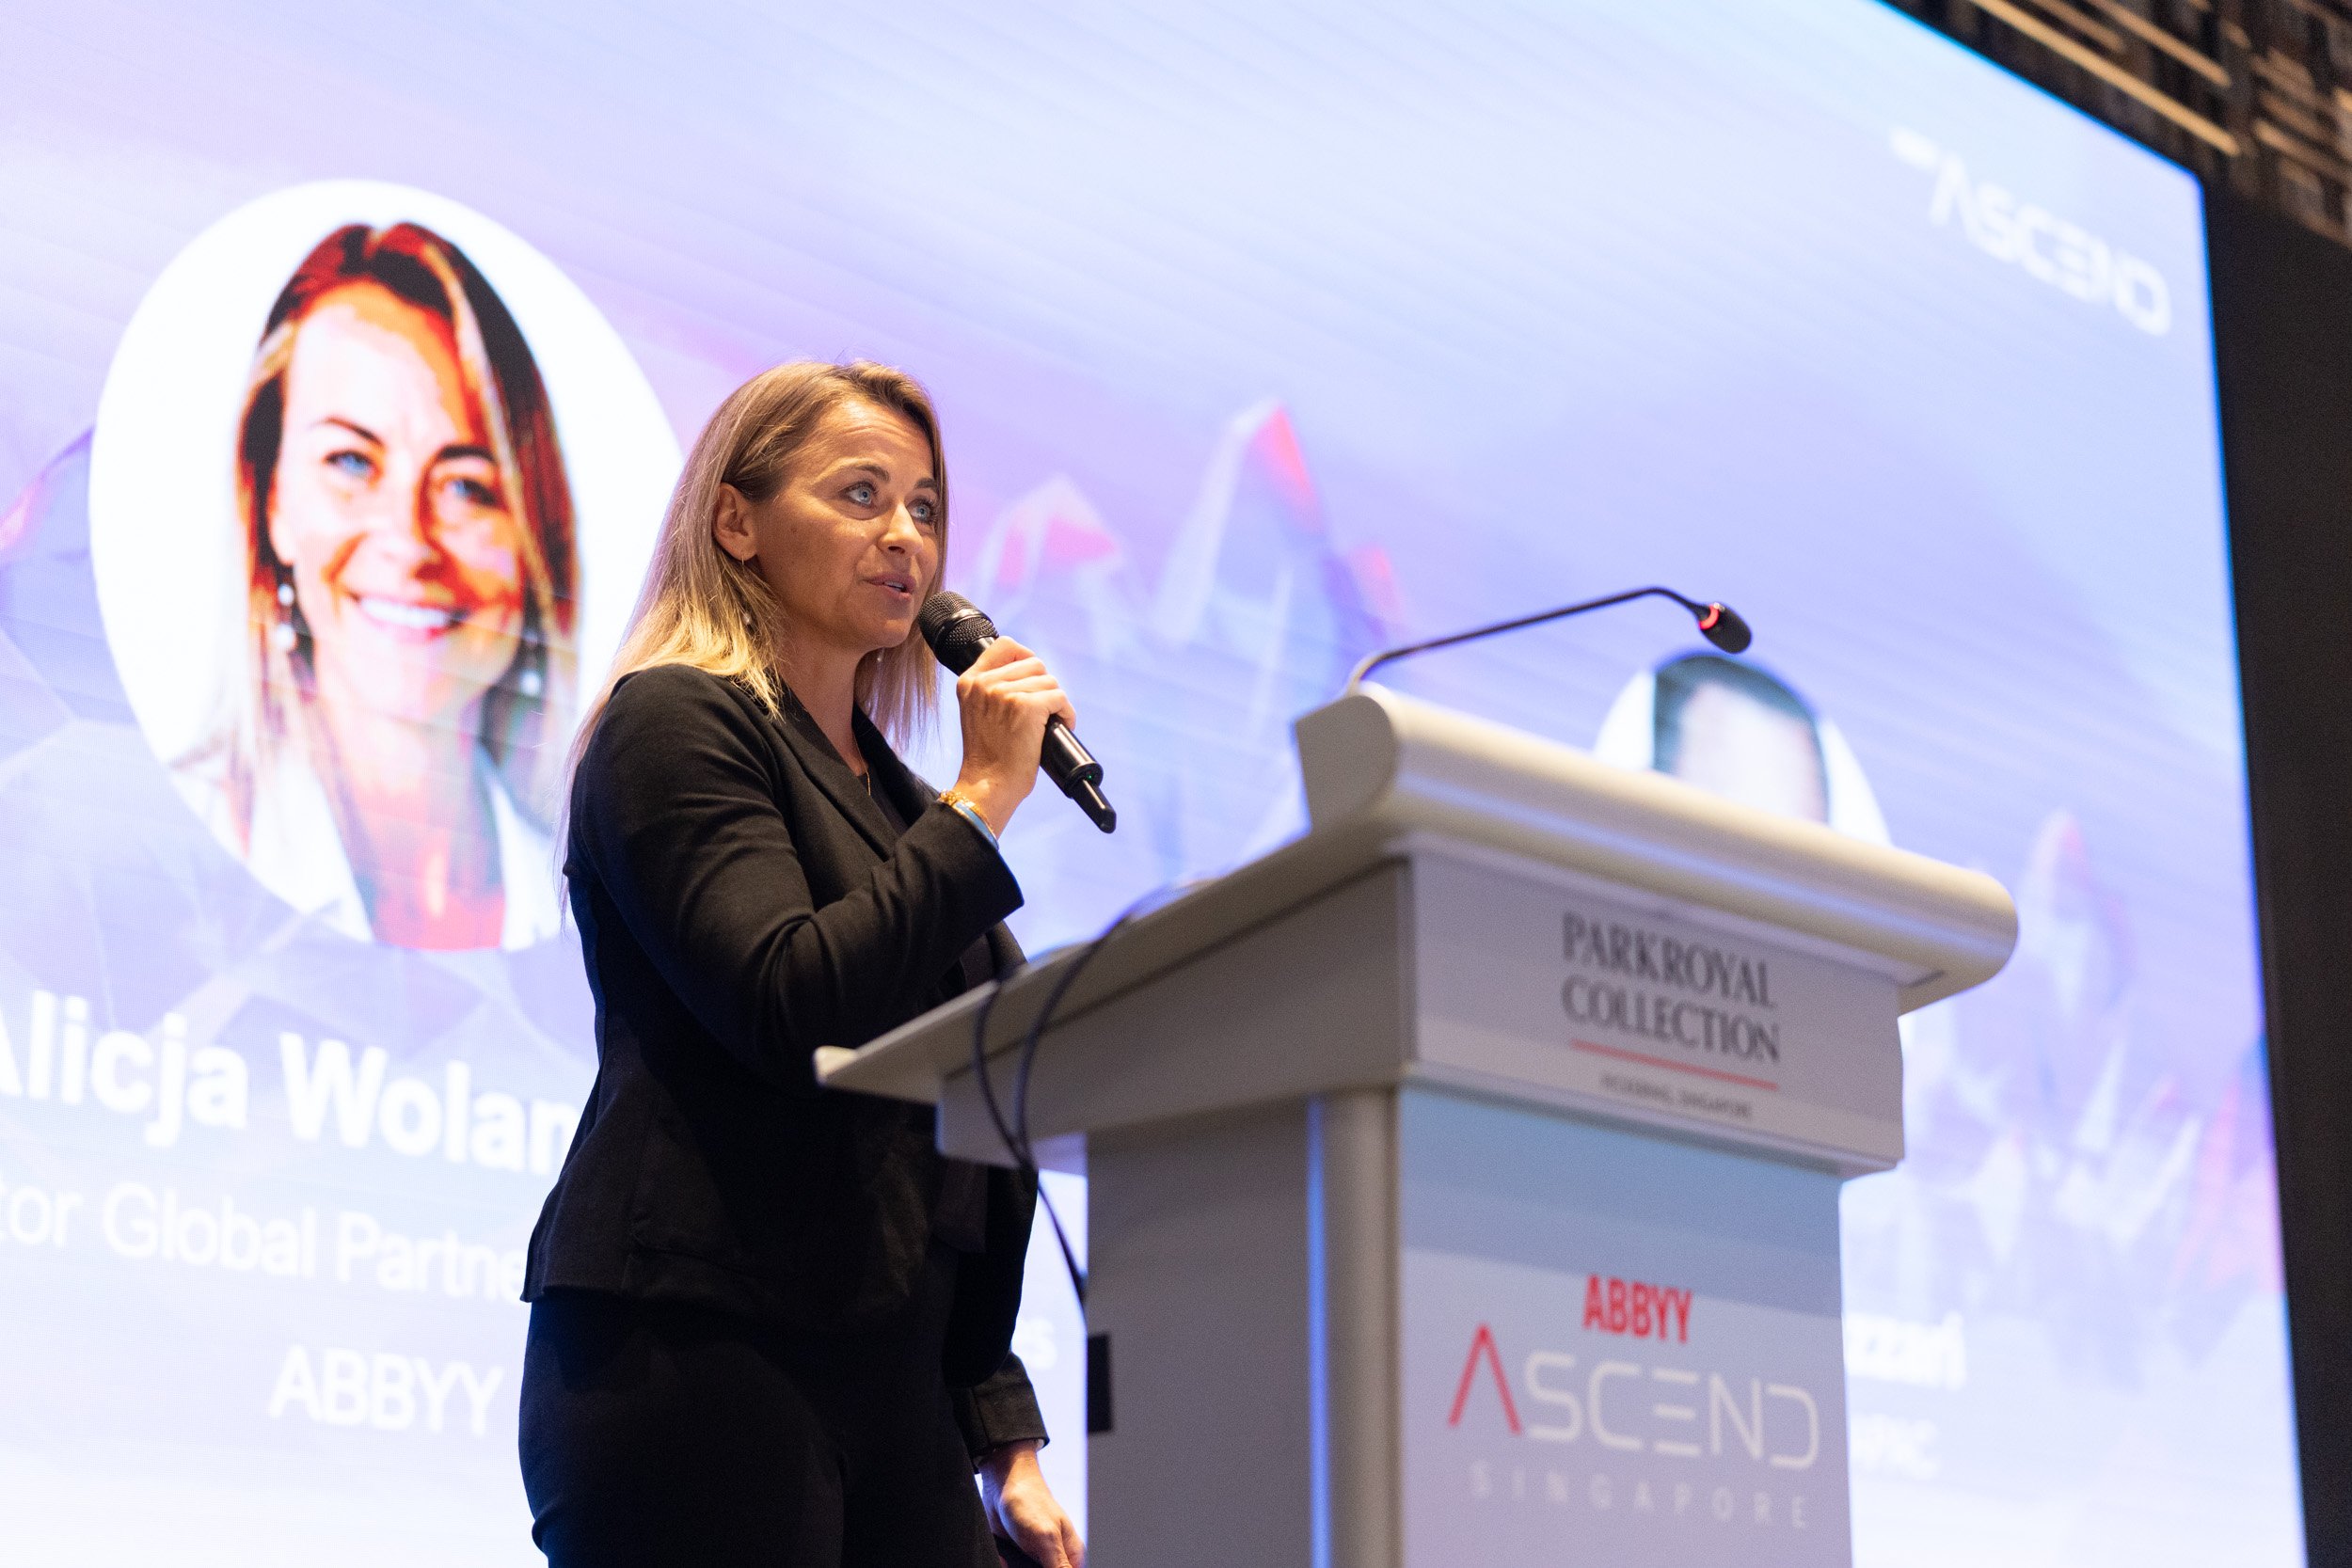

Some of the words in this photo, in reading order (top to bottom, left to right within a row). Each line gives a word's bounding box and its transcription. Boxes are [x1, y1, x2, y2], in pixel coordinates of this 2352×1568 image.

[1562, 911, 1777, 1010] PARKROYAL
[1560, 974, 1781, 1064] COLLECTION
[102, 1181, 317, 1279] Global
[1583, 1274, 1692, 1344] ABBYY
[267, 1344, 504, 1438] ABBYY
[1448, 1323, 1820, 1470] ASCEND
[1470, 1459, 1808, 1529] SINGAPORE
